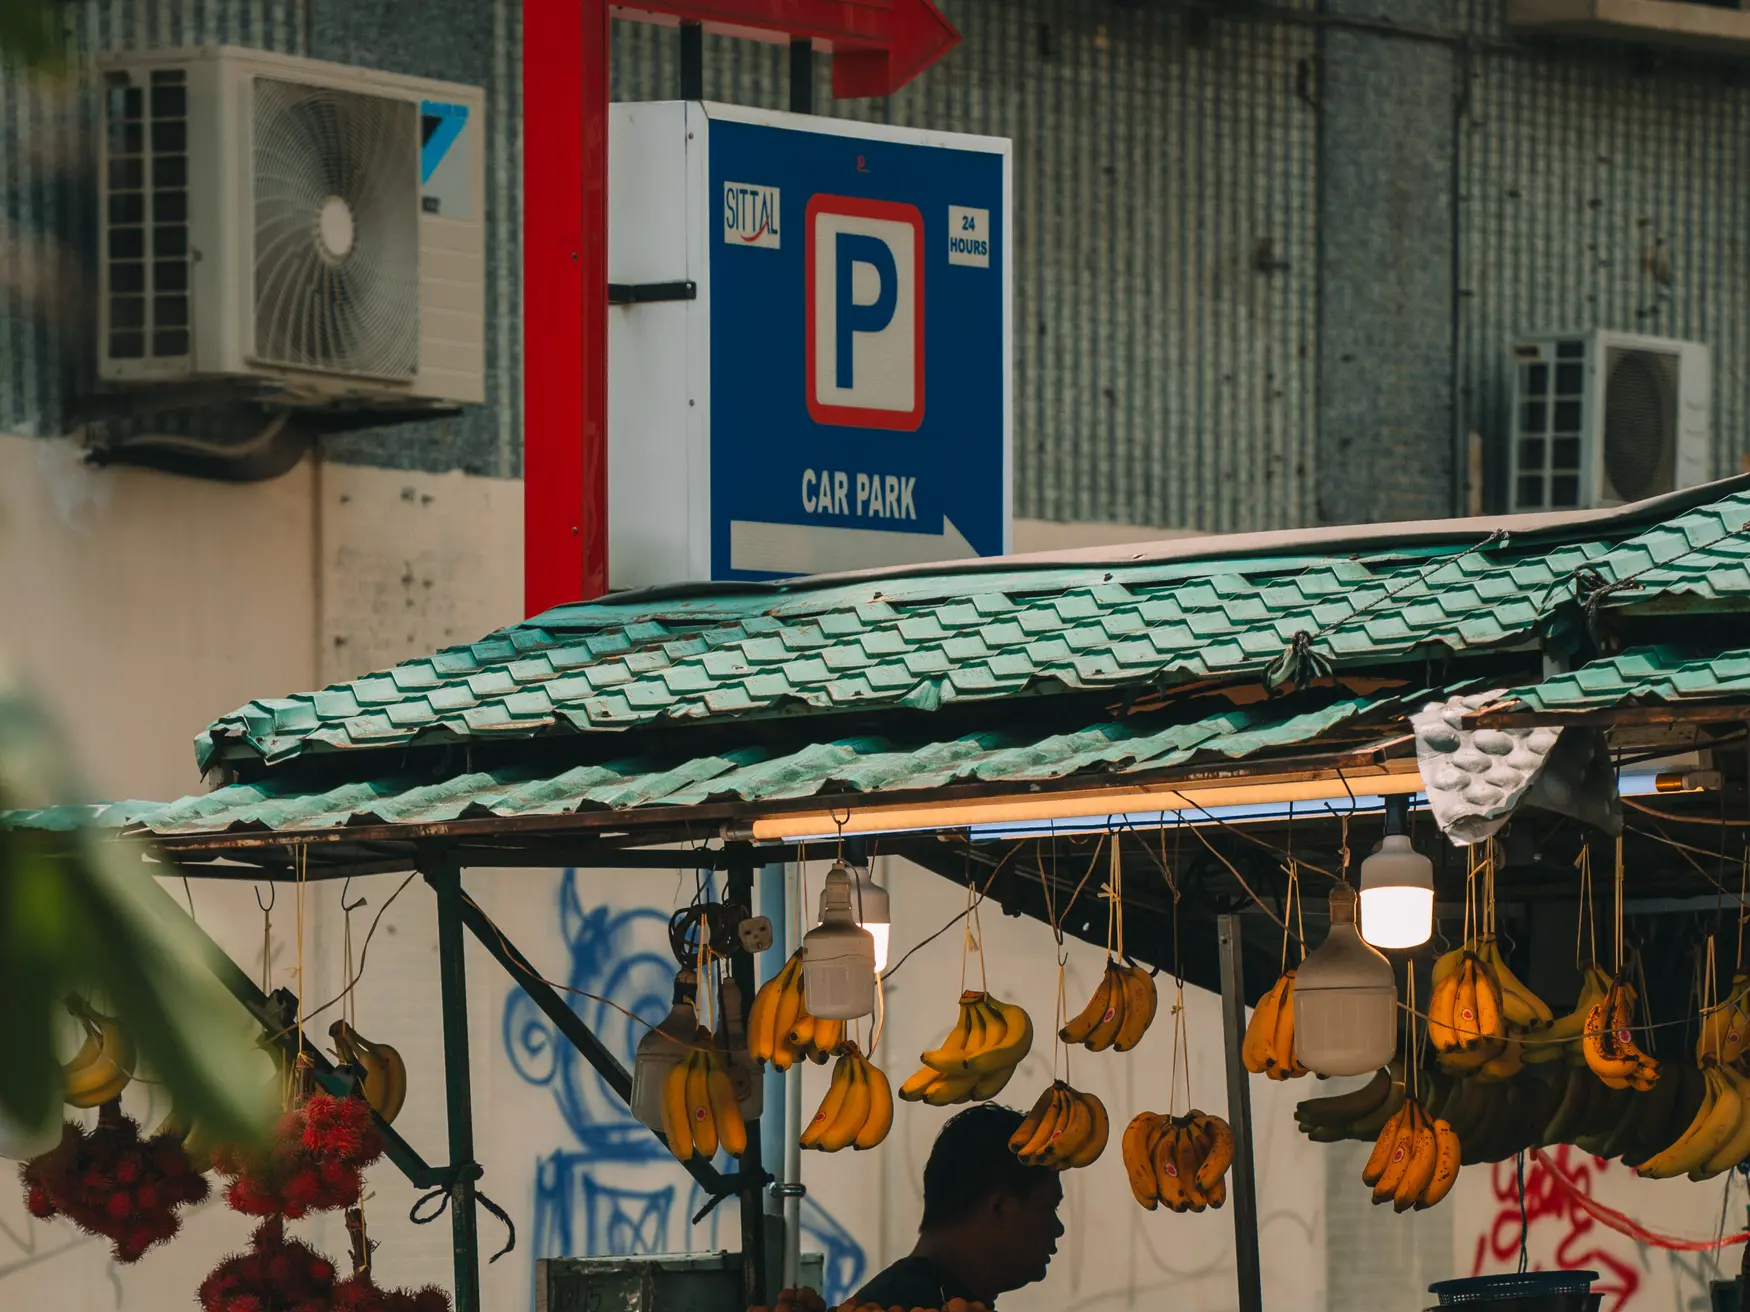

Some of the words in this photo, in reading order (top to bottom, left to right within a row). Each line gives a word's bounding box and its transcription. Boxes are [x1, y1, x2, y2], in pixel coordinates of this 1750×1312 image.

[725, 187, 779, 240] SITTAL
[961, 214, 976, 232] 24
[950, 236, 988, 257] HOURS
[835, 231, 899, 390] P
[802, 467, 848, 515] CAR
[856, 472, 918, 521] PARK
